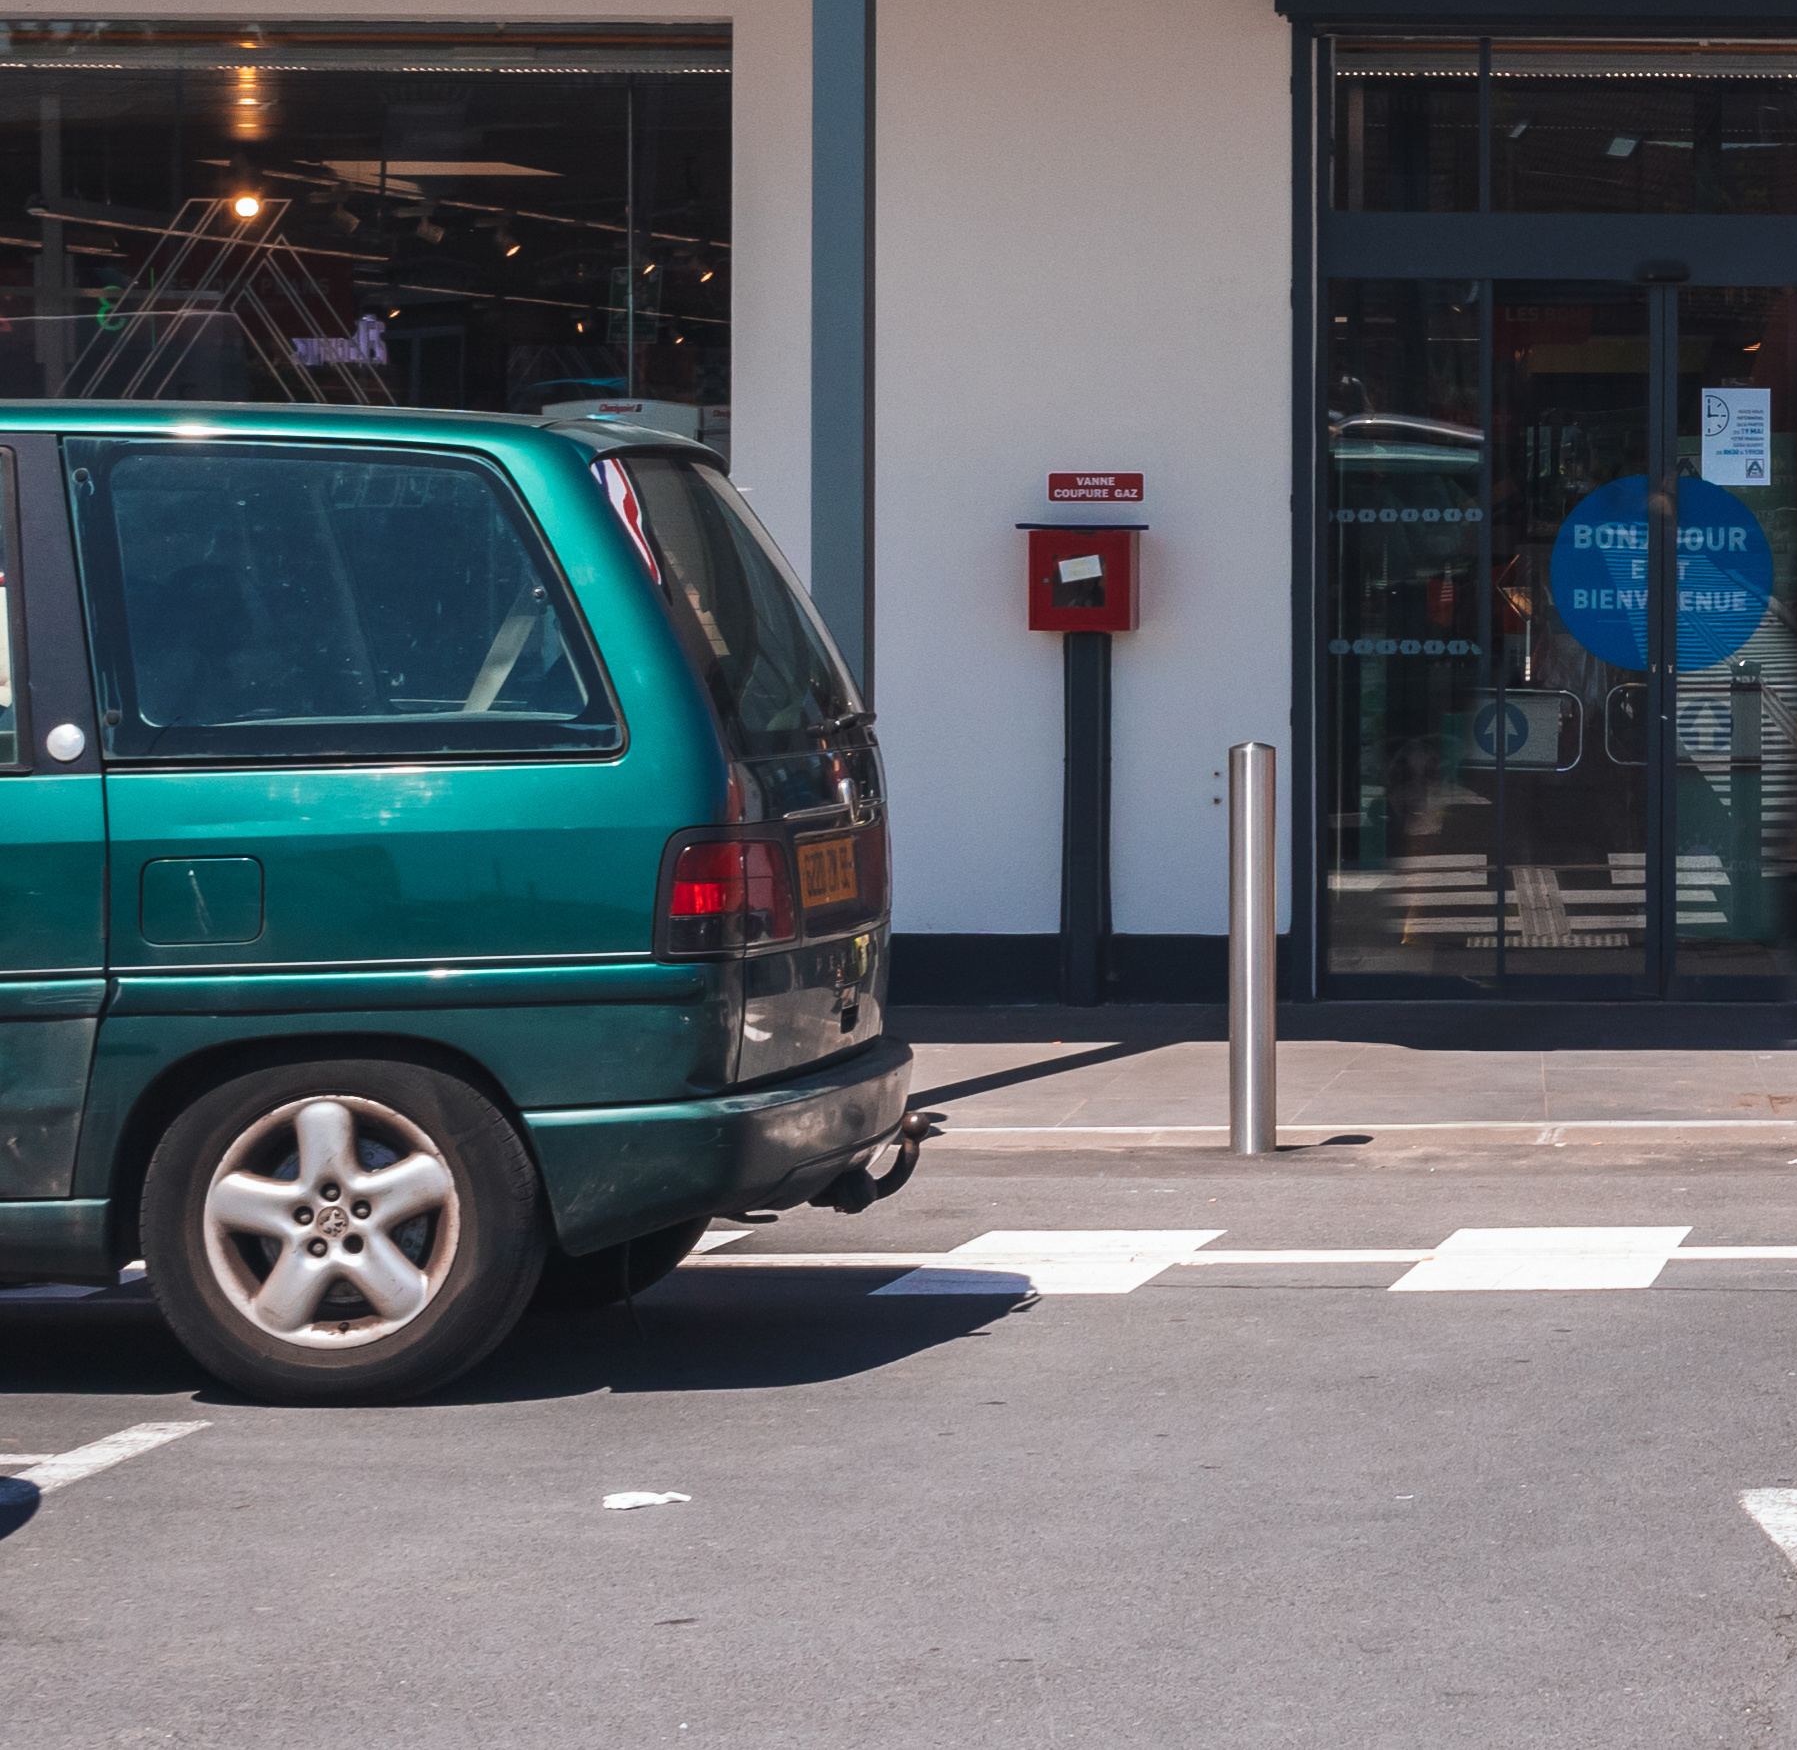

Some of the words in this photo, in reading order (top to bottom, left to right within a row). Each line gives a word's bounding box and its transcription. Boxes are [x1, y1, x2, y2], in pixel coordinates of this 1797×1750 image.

[1075, 476, 1116, 487] VANNE
[1053, 488, 1110, 499] COUPURE
[1114, 488, 1139, 499] GAZ
